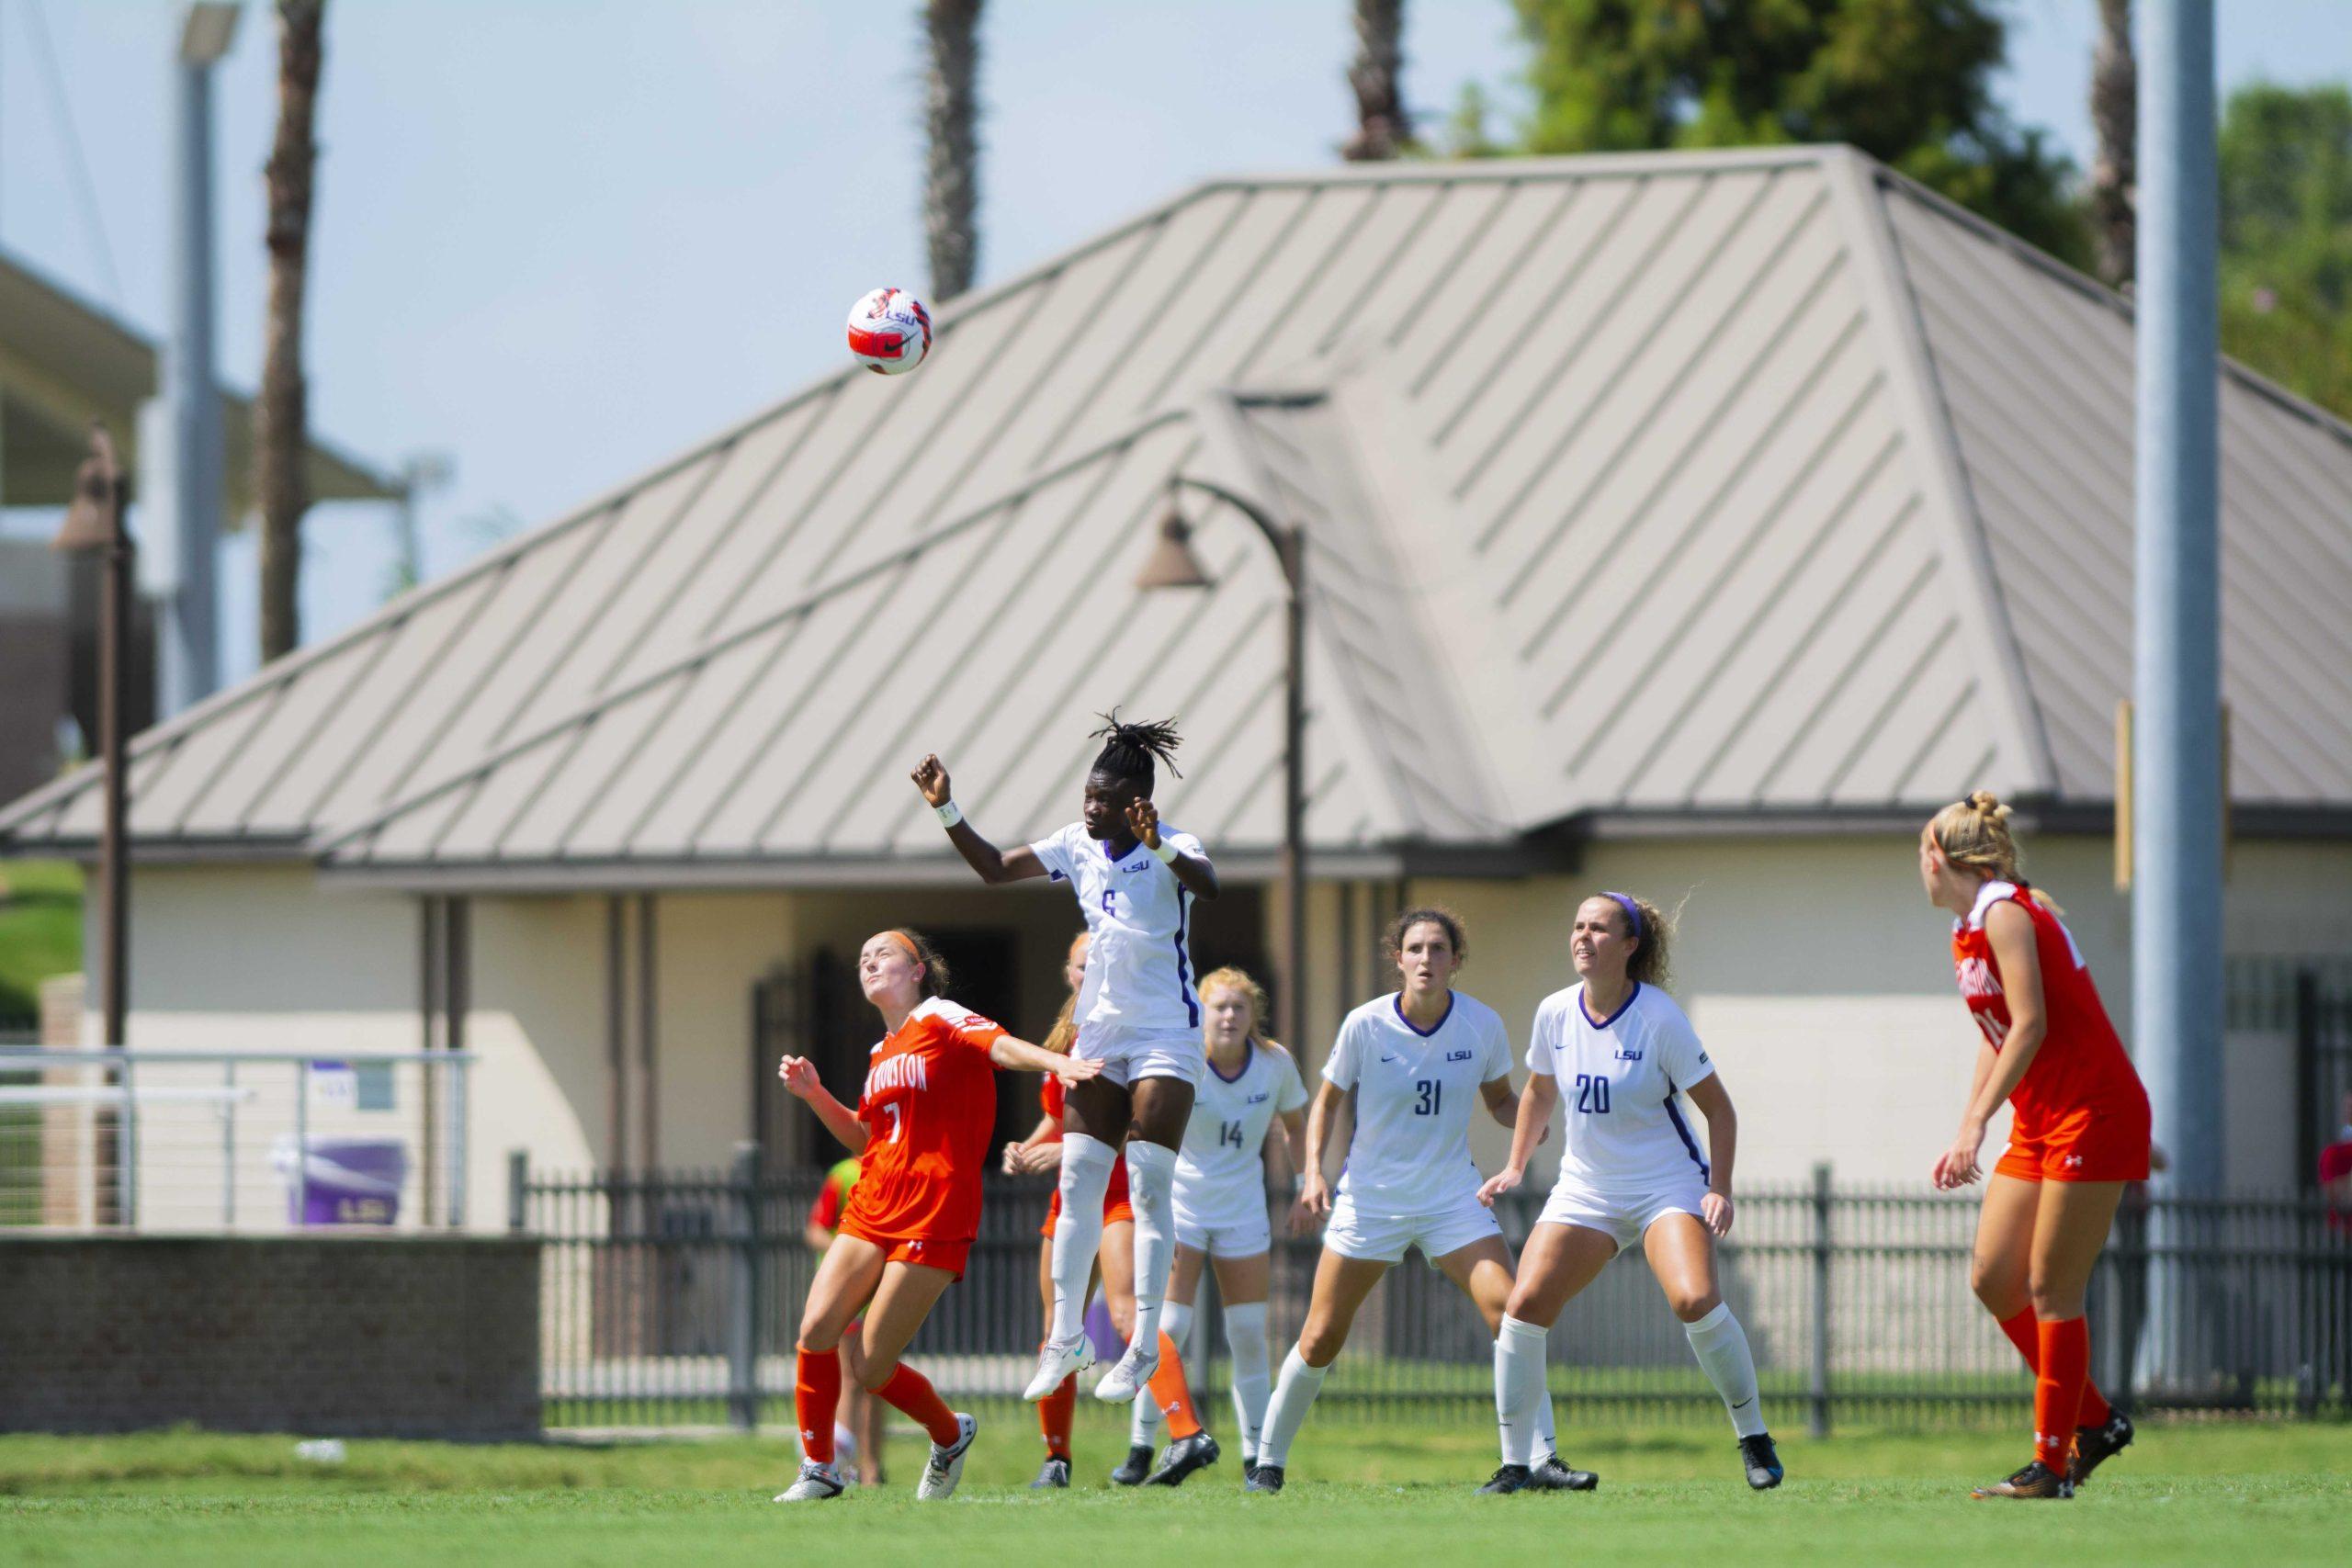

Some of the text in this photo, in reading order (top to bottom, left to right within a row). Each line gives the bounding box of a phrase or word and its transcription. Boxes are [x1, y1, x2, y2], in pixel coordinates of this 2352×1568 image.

[886, 310, 916, 326] LSU
[1123, 860, 1149, 874] LSU
[1447, 1050, 1472, 1062] LSU
[1614, 1049, 1643, 1061] LSU
[874, 1053, 927, 1093] HOUSTON
[1248, 1090, 1269, 1104] LSU
[1415, 1078, 1442, 1115] 31
[1576, 1073, 1611, 1114] 20
[883, 1101, 901, 1144] 7
[1220, 1120, 1243, 1149] 14
